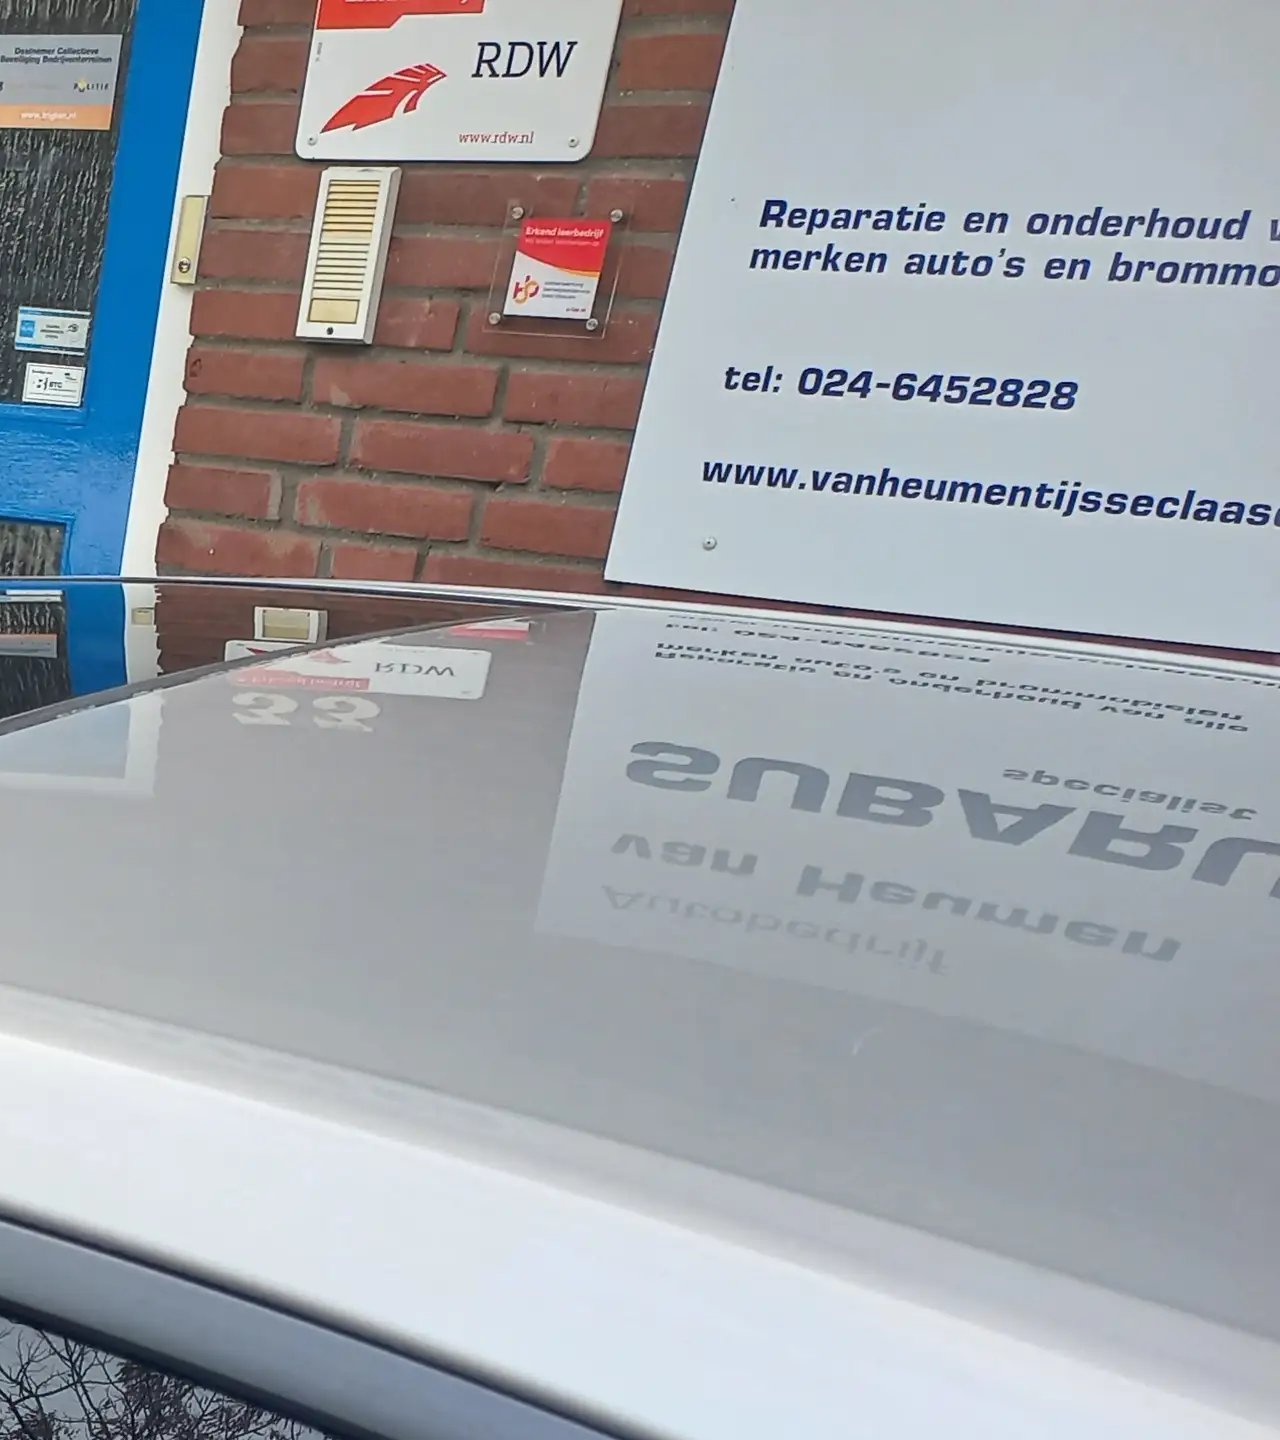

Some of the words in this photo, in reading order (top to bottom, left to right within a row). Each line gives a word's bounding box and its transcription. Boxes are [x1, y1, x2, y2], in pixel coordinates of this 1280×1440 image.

[471, 40, 578, 79] RDW
[458, 130, 534, 145] www.rdw.nl
[525, 226, 557, 237] Erkend
[557, 227, 605, 239] leerbedrijf
[759, 199, 946, 236] Reparatie
[962, 211, 1009, 234] en
[1026, 206, 1252, 241] onderhoud
[749, 243, 888, 274] merken
[903, 248, 1026, 279] auto's
[1044, 256, 1091, 281] en
[1108, 251, 1280, 287] brommo
[724, 366, 783, 393] tel:
[797, 367, 1079, 411] 024-6452828
[702, 461, 1280, 528] www.vanheumentijsseclaas
